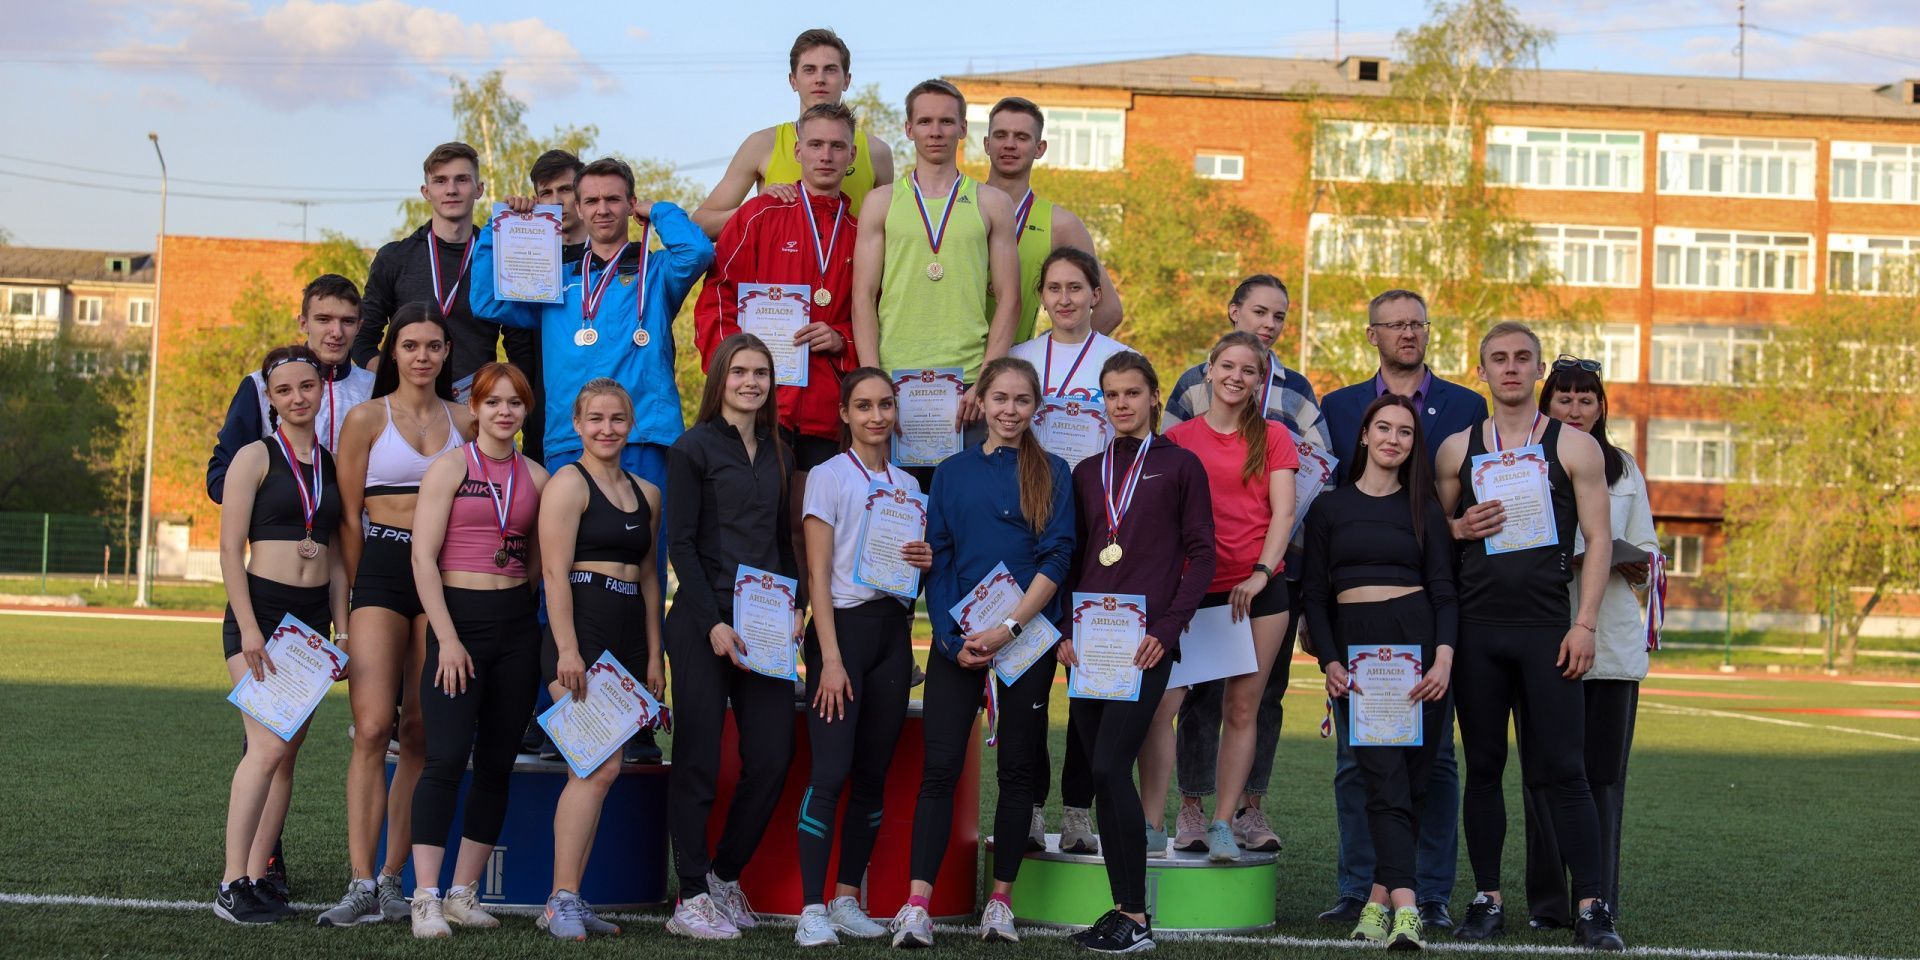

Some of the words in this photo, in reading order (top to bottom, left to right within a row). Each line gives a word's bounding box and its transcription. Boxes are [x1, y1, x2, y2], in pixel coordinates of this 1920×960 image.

[509, 226, 545, 235] ДИПЛОМ
[755, 307, 794, 315] ДИПЛОМ
[908, 389, 947, 398] ДИПЛОМ
[1051, 421, 1090, 432] ДИПЛОМ
[1493, 470, 1530, 484] ДИПЛОМ
[880, 507, 914, 521] ДИПЛОМ
[381, 529, 413, 543] PR
[605, 577, 639, 595] FASHION
[748, 594, 782, 608] ДИПЛОМ
[978, 590, 1005, 622] ДИПЛОМ
[1091, 617, 1129, 627] ДИПЛОМ
[286, 643, 323, 670] ДИПЛОМ
[1366, 668, 1405, 676] ДИПЛОМ
[601, 681, 633, 714] ДИПЛОМ
